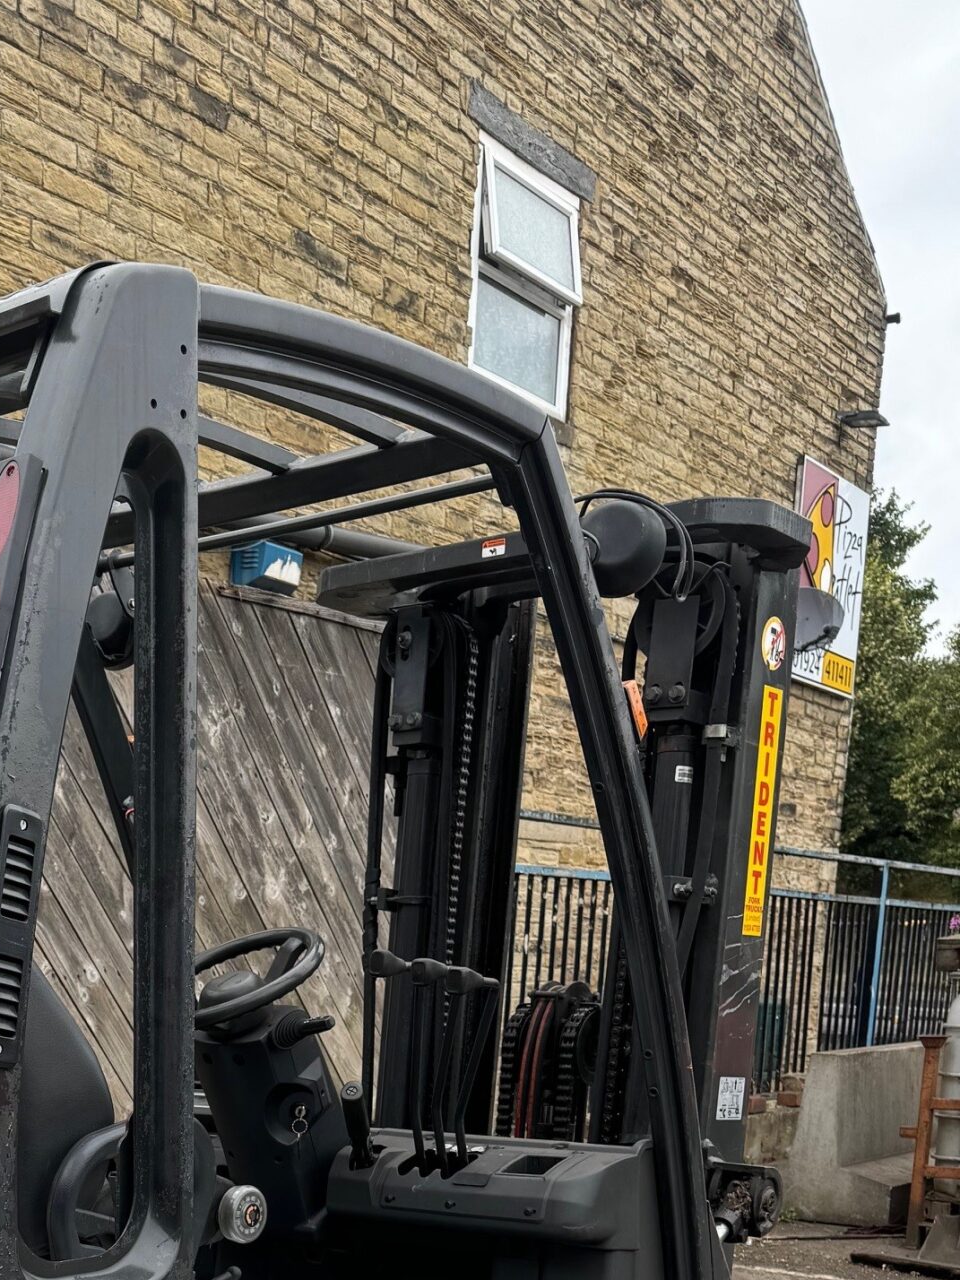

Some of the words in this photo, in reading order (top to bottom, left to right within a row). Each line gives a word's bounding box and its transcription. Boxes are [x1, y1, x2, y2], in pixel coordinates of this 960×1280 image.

[834, 494, 863, 566] Pizza
[825, 658, 853, 688] 411411
[751, 691, 779, 896] TRIDENT
